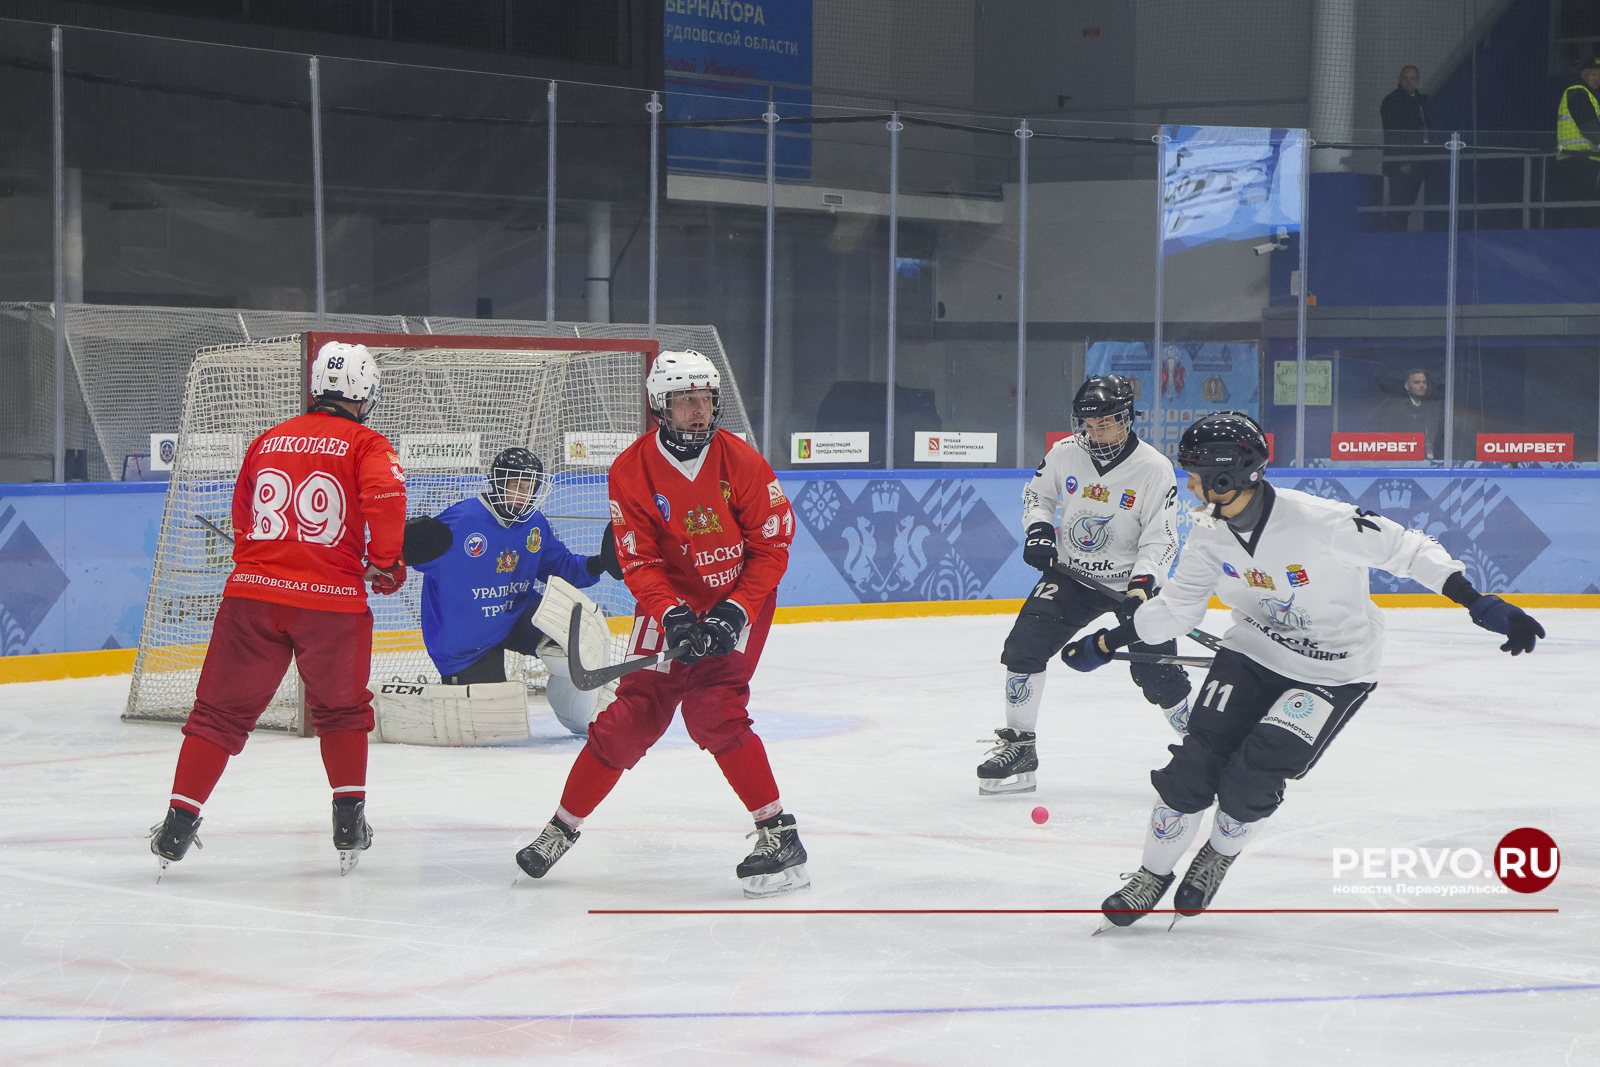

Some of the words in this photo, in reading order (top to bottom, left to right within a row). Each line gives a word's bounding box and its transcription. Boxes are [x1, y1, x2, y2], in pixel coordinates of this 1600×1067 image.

[664, 24, 741, 47] РДЛОВСКОЙ
[744, 35, 798, 56] ОБЛАСТИ
[327, 356, 345, 370] 68
[259, 436, 350, 457] НИКОЛАЕВ
[665, 439, 698, 452] CC
[1338, 441, 1418, 453] OLIMPBET
[1483, 442, 1566, 454] OLIMPBET
[246, 467, 347, 548] 89
[761, 508, 794, 539] 91
[232, 573, 308, 591] СВЕРДЛОВСКАЯ
[310, 583, 358, 596] ОБЛАСТЬ
[1033, 581, 1060, 601] 12
[381, 684, 425, 696] CCM
[1203, 679, 1234, 713] 11
